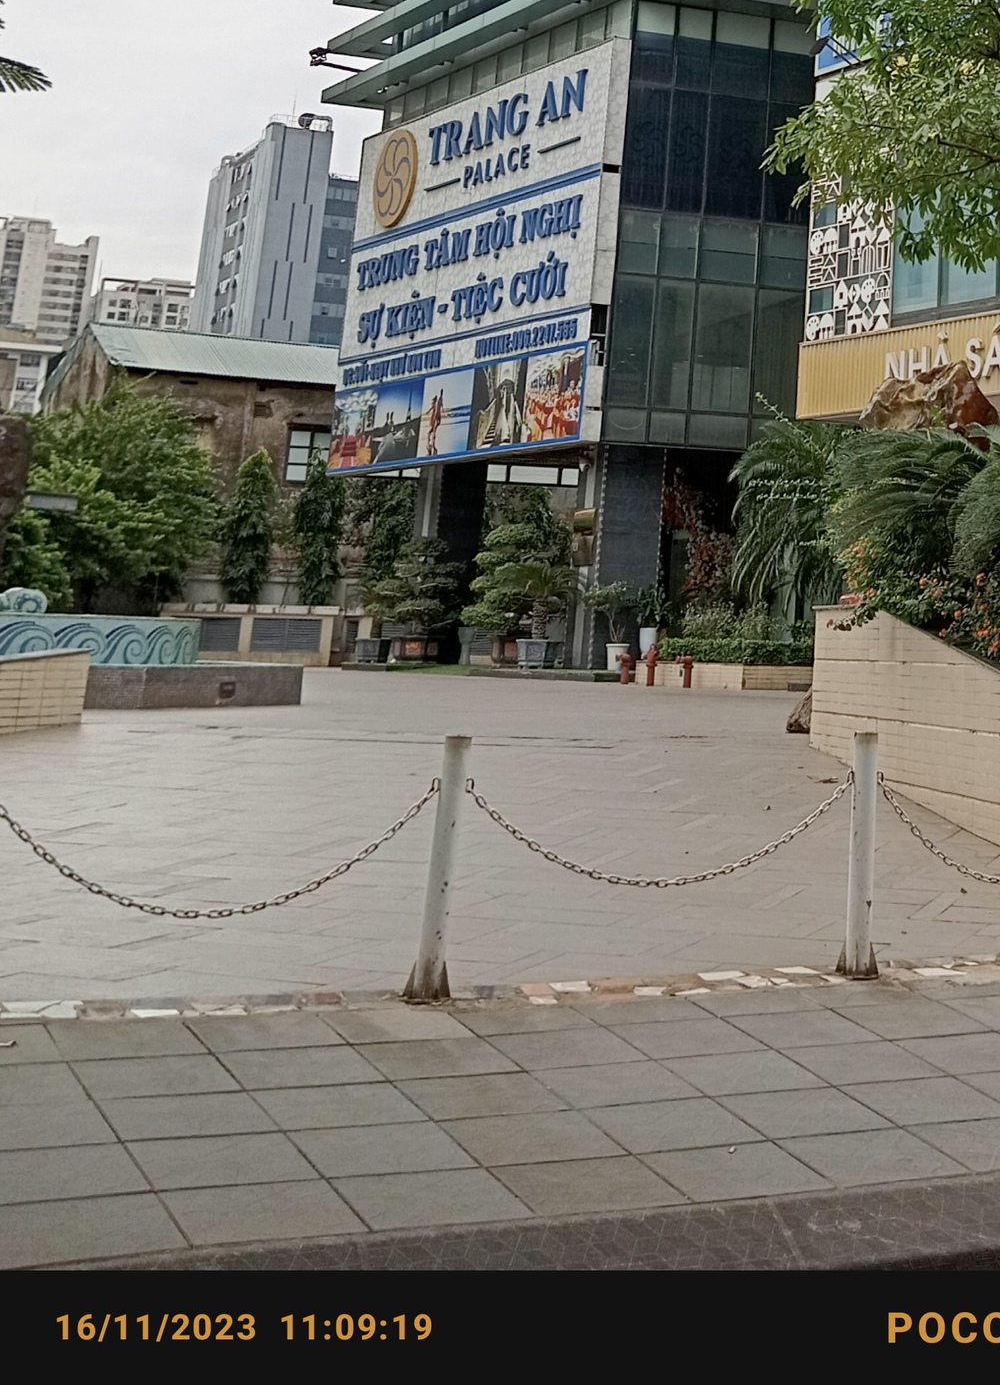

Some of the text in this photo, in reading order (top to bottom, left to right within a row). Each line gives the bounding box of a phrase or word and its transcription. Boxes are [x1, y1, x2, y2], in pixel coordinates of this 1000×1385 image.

[428, 68, 589, 165] TRANG AN
[463, 143, 531, 189] PALACE
[356, 194, 584, 291] TRUNG TÂM HỘI NGHỊ
[357, 302, 386, 349] SỰ
[385, 290, 436, 340] KIỆN
[451, 272, 504, 324] TIỆC
[509, 250, 568, 306] CƯỚI
[884, 331, 951, 381] NHÀ
